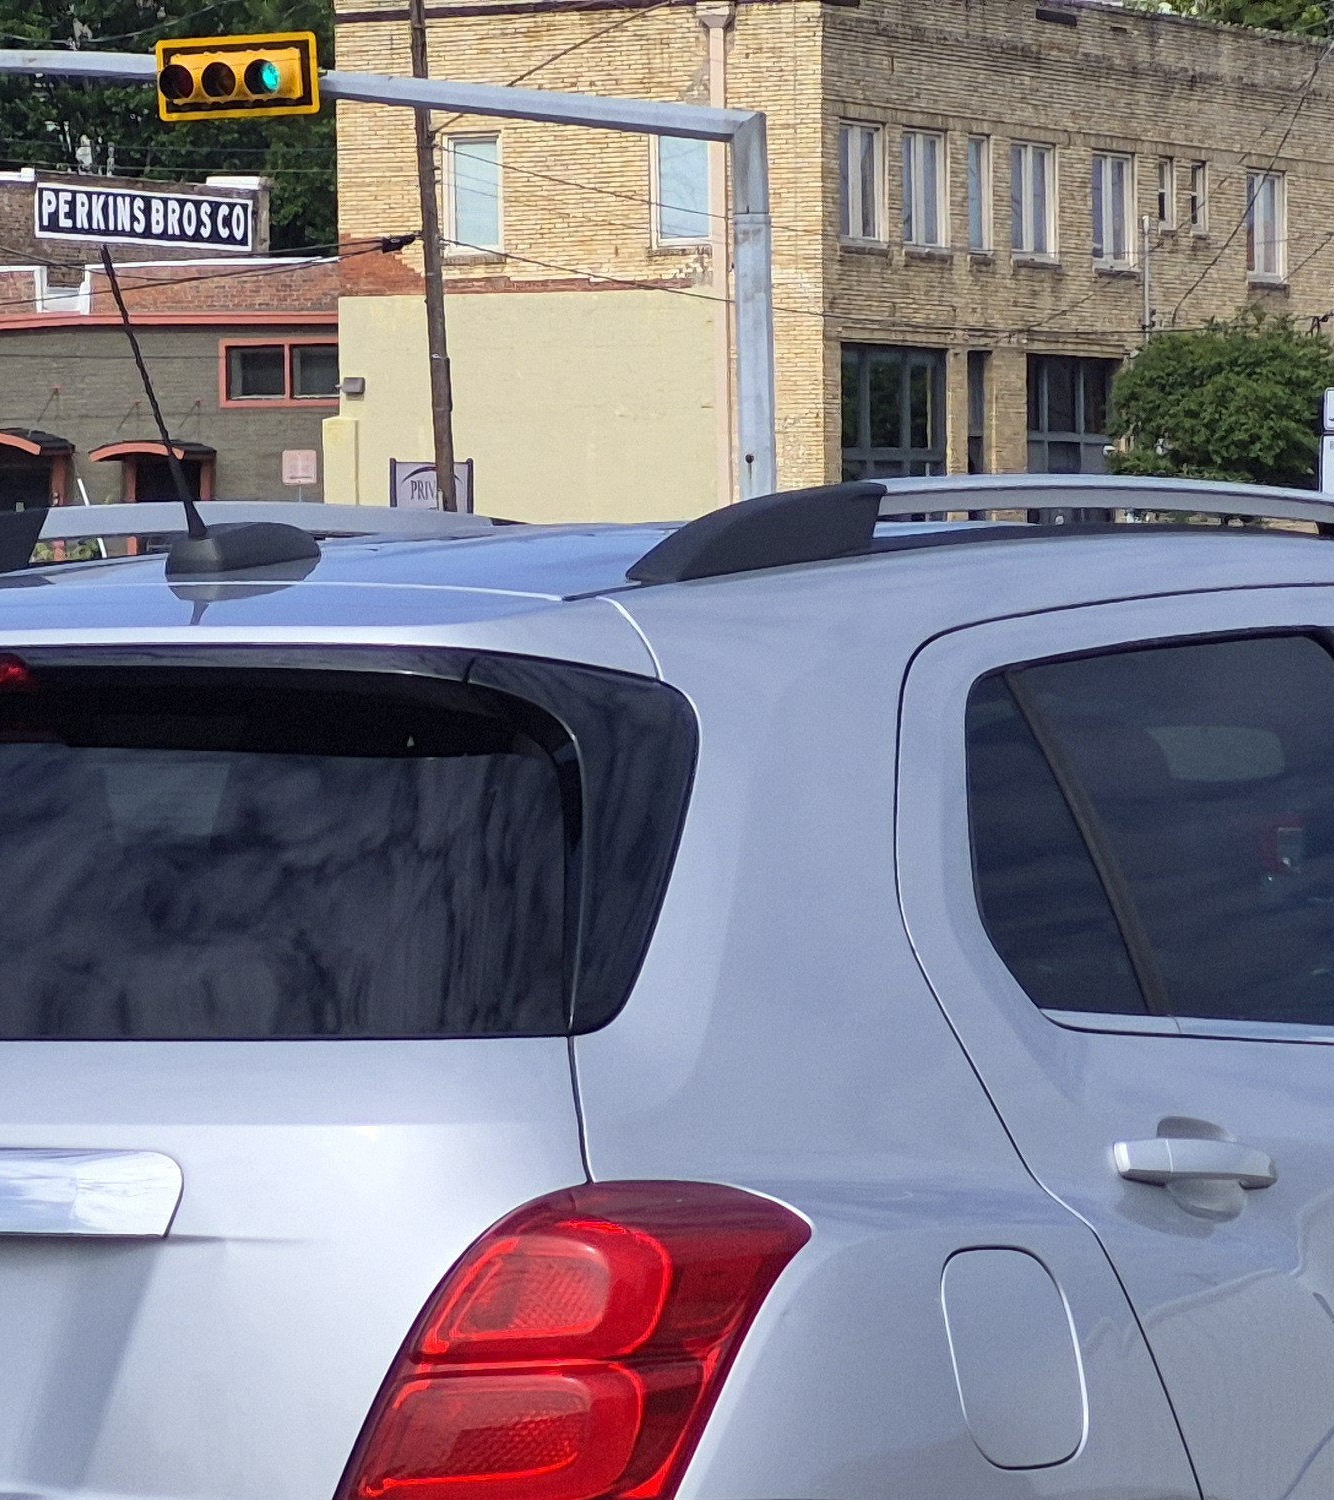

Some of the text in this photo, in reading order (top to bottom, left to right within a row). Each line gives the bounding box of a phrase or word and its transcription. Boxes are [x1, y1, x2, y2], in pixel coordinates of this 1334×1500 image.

[42, 189, 245, 241] PERKINS BROS CO
